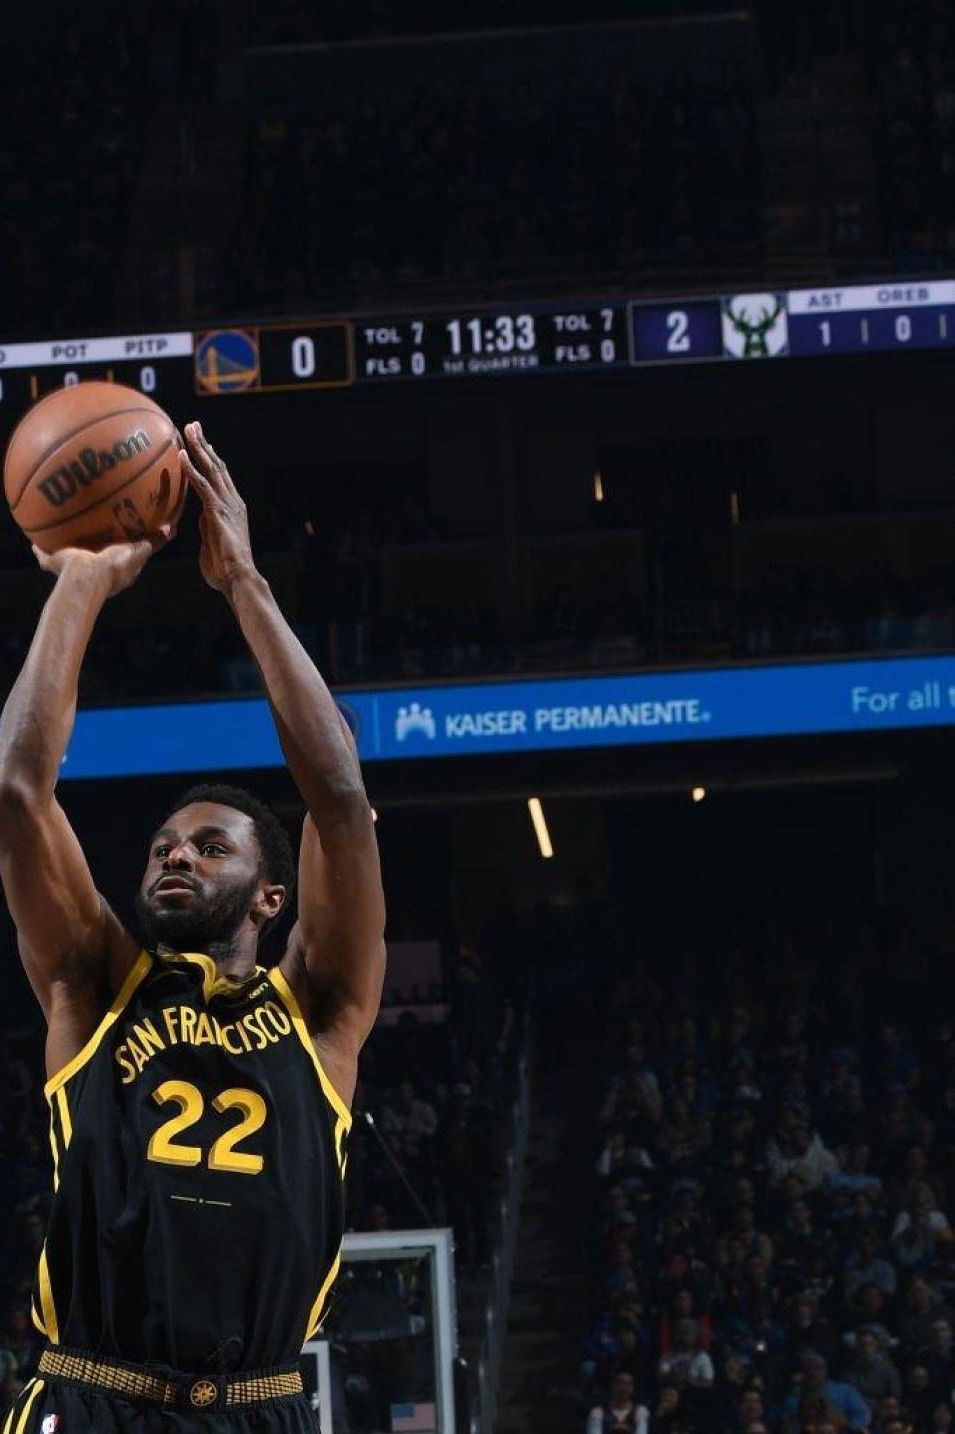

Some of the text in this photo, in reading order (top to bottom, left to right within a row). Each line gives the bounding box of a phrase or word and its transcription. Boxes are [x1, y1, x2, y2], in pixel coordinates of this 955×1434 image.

[364, 321, 424, 345] TOL 7
[446, 314, 536, 355] 11:33
[553, 308, 613, 331] TOL 7
[666, 311, 691, 353] 2
[819, 314, 911, 347] 1 0
[51, 344, 88, 359] POT
[125, 338, 168, 354] PITP
[292, 336, 315, 378] 0
[365, 352, 425, 375] FLS 0
[554, 339, 615, 362] FLS 0
[141, 366, 156, 392] 0
[37, 428, 152, 508] Wilson
[852, 686, 900, 714] For
[907, 680, 941, 711] all
[446, 710, 527, 738] KAISER
[115, 1018, 166, 1084] SAN
[146, 1080, 267, 1176] 22
